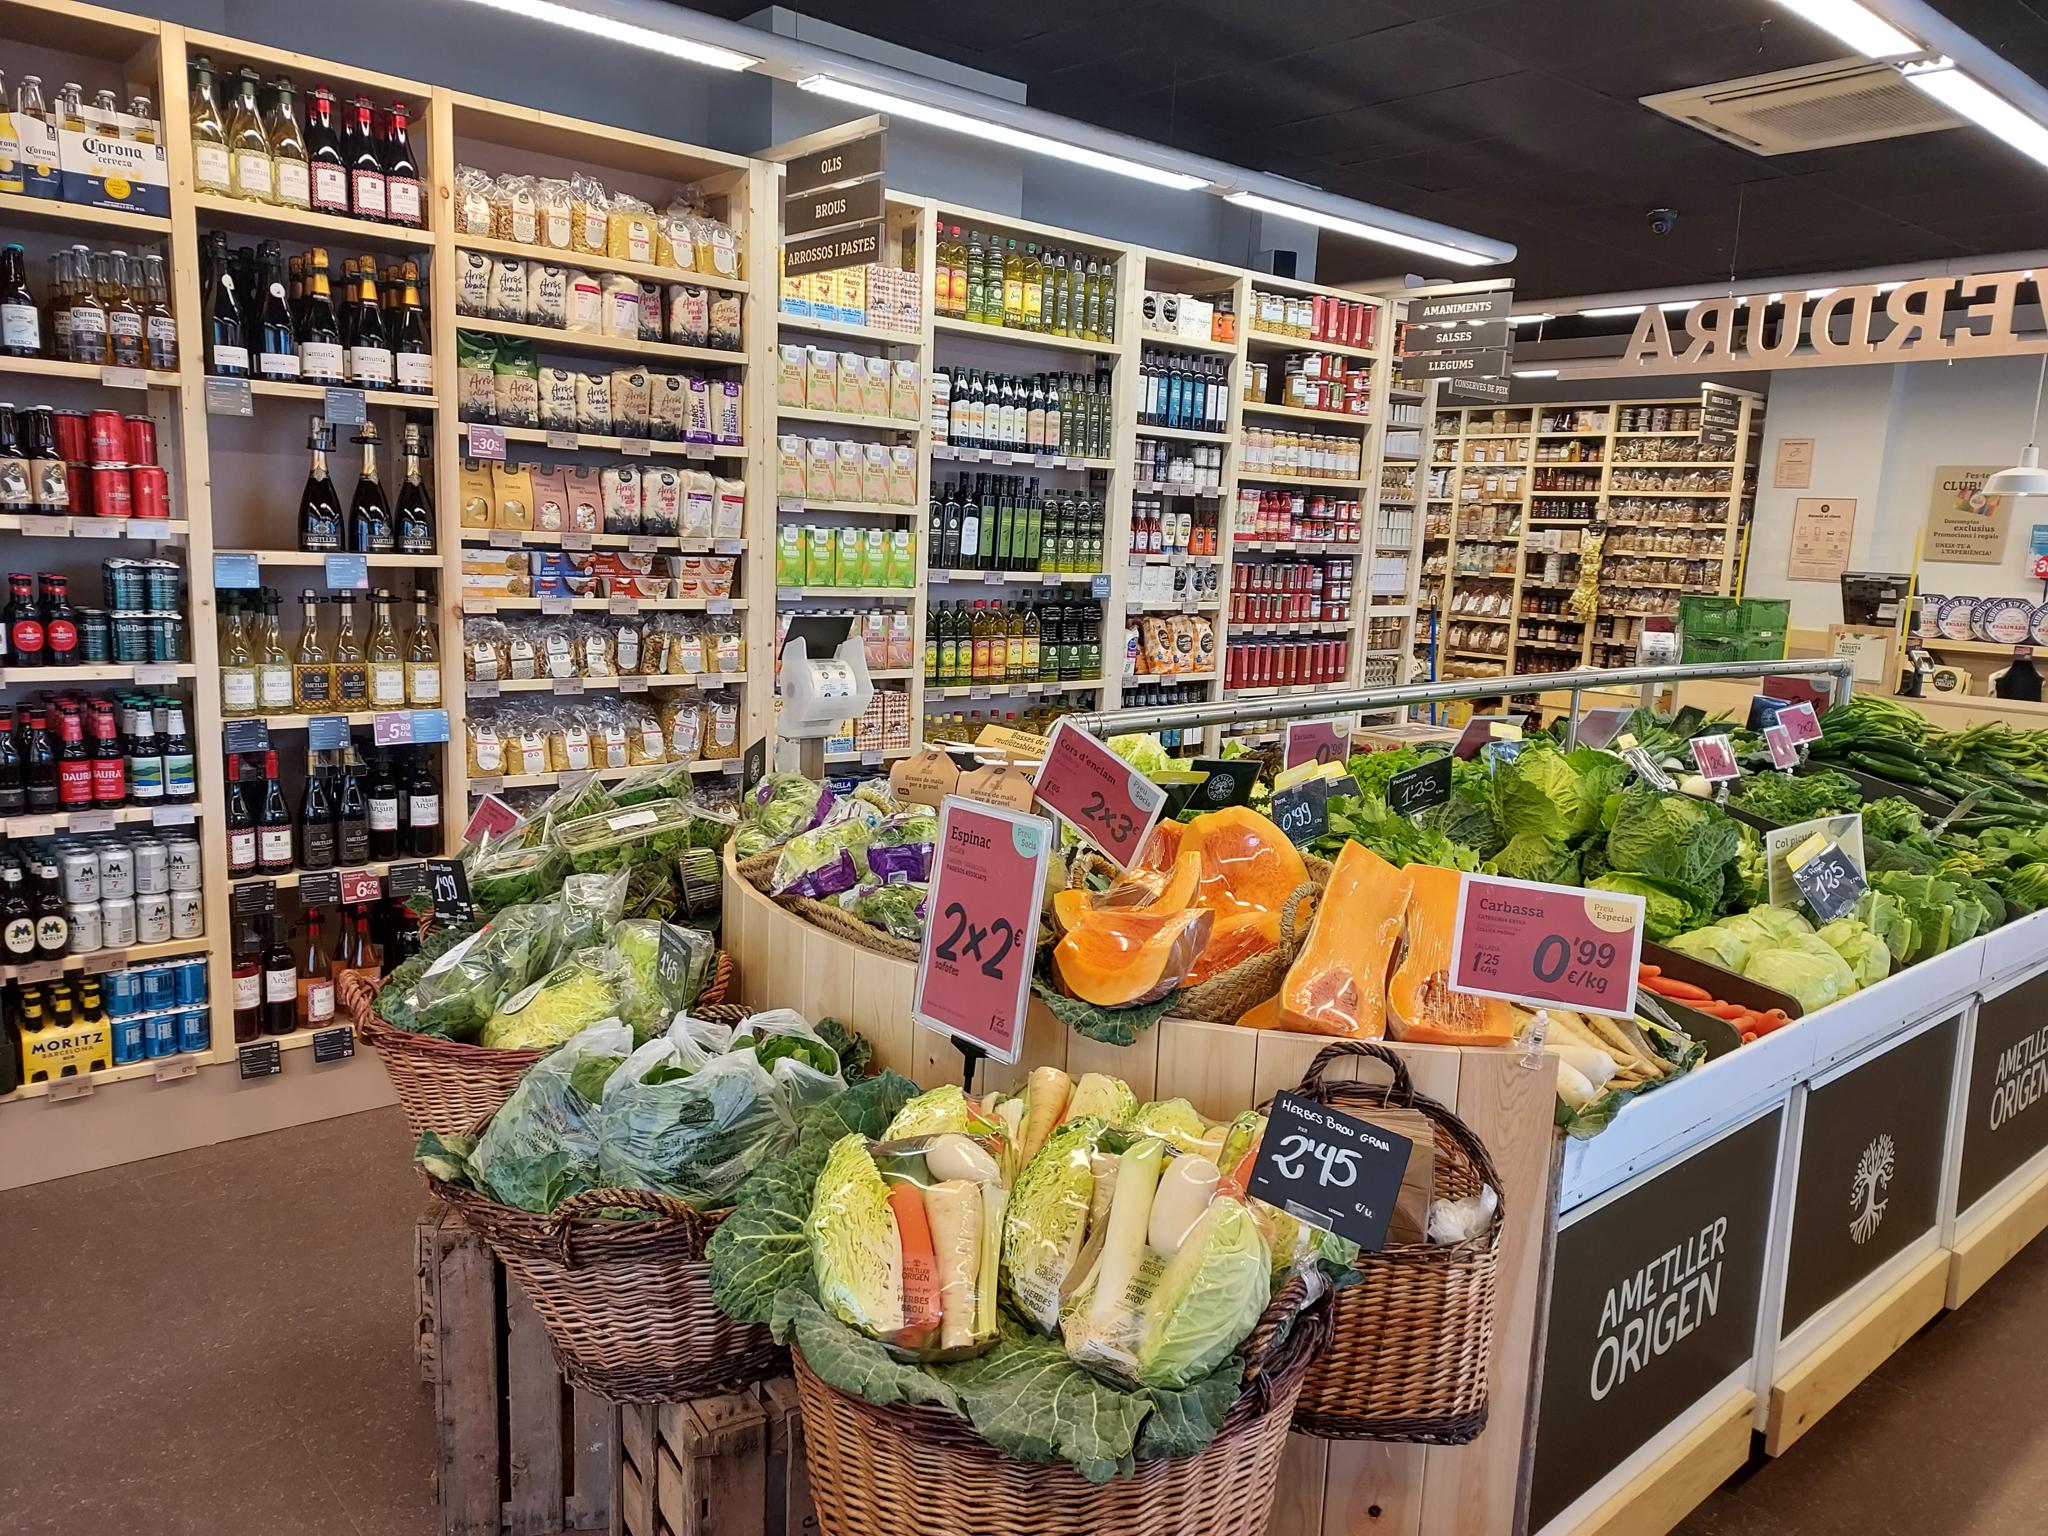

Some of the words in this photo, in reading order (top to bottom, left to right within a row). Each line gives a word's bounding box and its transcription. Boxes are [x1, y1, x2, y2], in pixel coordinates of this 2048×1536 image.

[25, 145, 57, 157] Corona
[82, 137, 144, 160] Corona
[98, 156, 133, 168] cerveza
[821, 156, 842, 174] OLIS
[815, 199, 846, 219] BROUS
[788, 243, 834, 266] ARROSSOS
[834, 243, 840, 257] I
[841, 236, 876, 257] PASTES
[869, 267, 892, 279] CALDO
[897, 272, 919, 283] CALDO
[73, 309, 102, 319] Corona
[1423, 301, 1492, 316] AMANIMENTS
[1436, 331, 1473, 343] SALSES
[1428, 359, 1474, 371] LLEGUMS
[509, 380, 534, 394] Arròs
[551, 383, 573, 395] Arròs
[586, 387, 608, 399] Arròs
[1454, 378, 1487, 392] CONSERVES
[1487, 383, 1495, 393] DE
[1495, 385, 1509, 395] PEIX
[1943, 480, 1982, 492] CLUB!
[1933, 531, 1972, 539] Promocions
[1977, 533, 1999, 541] regals
[1953, 525, 1996, 533] exclusius
[306, 535, 338, 544] AMETLLER
[403, 538, 433, 546] AMETLLER
[1011, 731, 1035, 744] Bosses
[993, 736, 1035, 753] reutilitzables
[1035, 747, 1046, 756] pe
[1060, 739, 1079, 755] Cors
[1079, 752, 1117, 786] d'enclam
[1133, 780, 1148, 796] Preu
[1135, 790, 1152, 808] Socis
[1282, 802, 1312, 832] 0'99
[951, 826, 992, 850] Espinac
[1017, 828, 1032, 840] Preu
[1021, 838, 1037, 851] Socis
[1775, 838, 1789, 850] Col
[434, 874, 458, 902] 1'99
[1815, 860, 1845, 902] 1'25
[1479, 898, 1545, 919] Carbassa
[1594, 903, 1615, 914] Preu
[1596, 911, 1633, 925] Especial
[1472, 951, 1501, 972] 1'25
[1532, 934, 1617, 985] 0'99
[1567, 969, 1609, 995] €/kg
[31, 1031, 104, 1055] MORITZ
[1994, 1024, 2048, 1086] AMETLLE
[1281, 1099, 1325, 1125] HERBES
[1326, 1115, 1355, 1138] BROU
[1359, 1133, 1391, 1153] GRAN
[1271, 1134, 1364, 1189] 2'45
[902, 1271, 931, 1282] ORIGEN
[1034, 1266, 1062, 1287] ORIGEN
[1139, 1265, 1164, 1279] ORIGEN
[1596, 1215, 1729, 1339] AMETLLER
[1023, 1286, 1053, 1309] HERBES
[1124, 1292, 1146, 1306] BROU
[1126, 1283, 1154, 1300] HERBES
[896, 1294, 930, 1305] HERBES
[1023, 1297, 1046, 1314] BROU
[901, 1304, 925, 1314] BROU
[1590, 1260, 1724, 1402] ORIGEN
